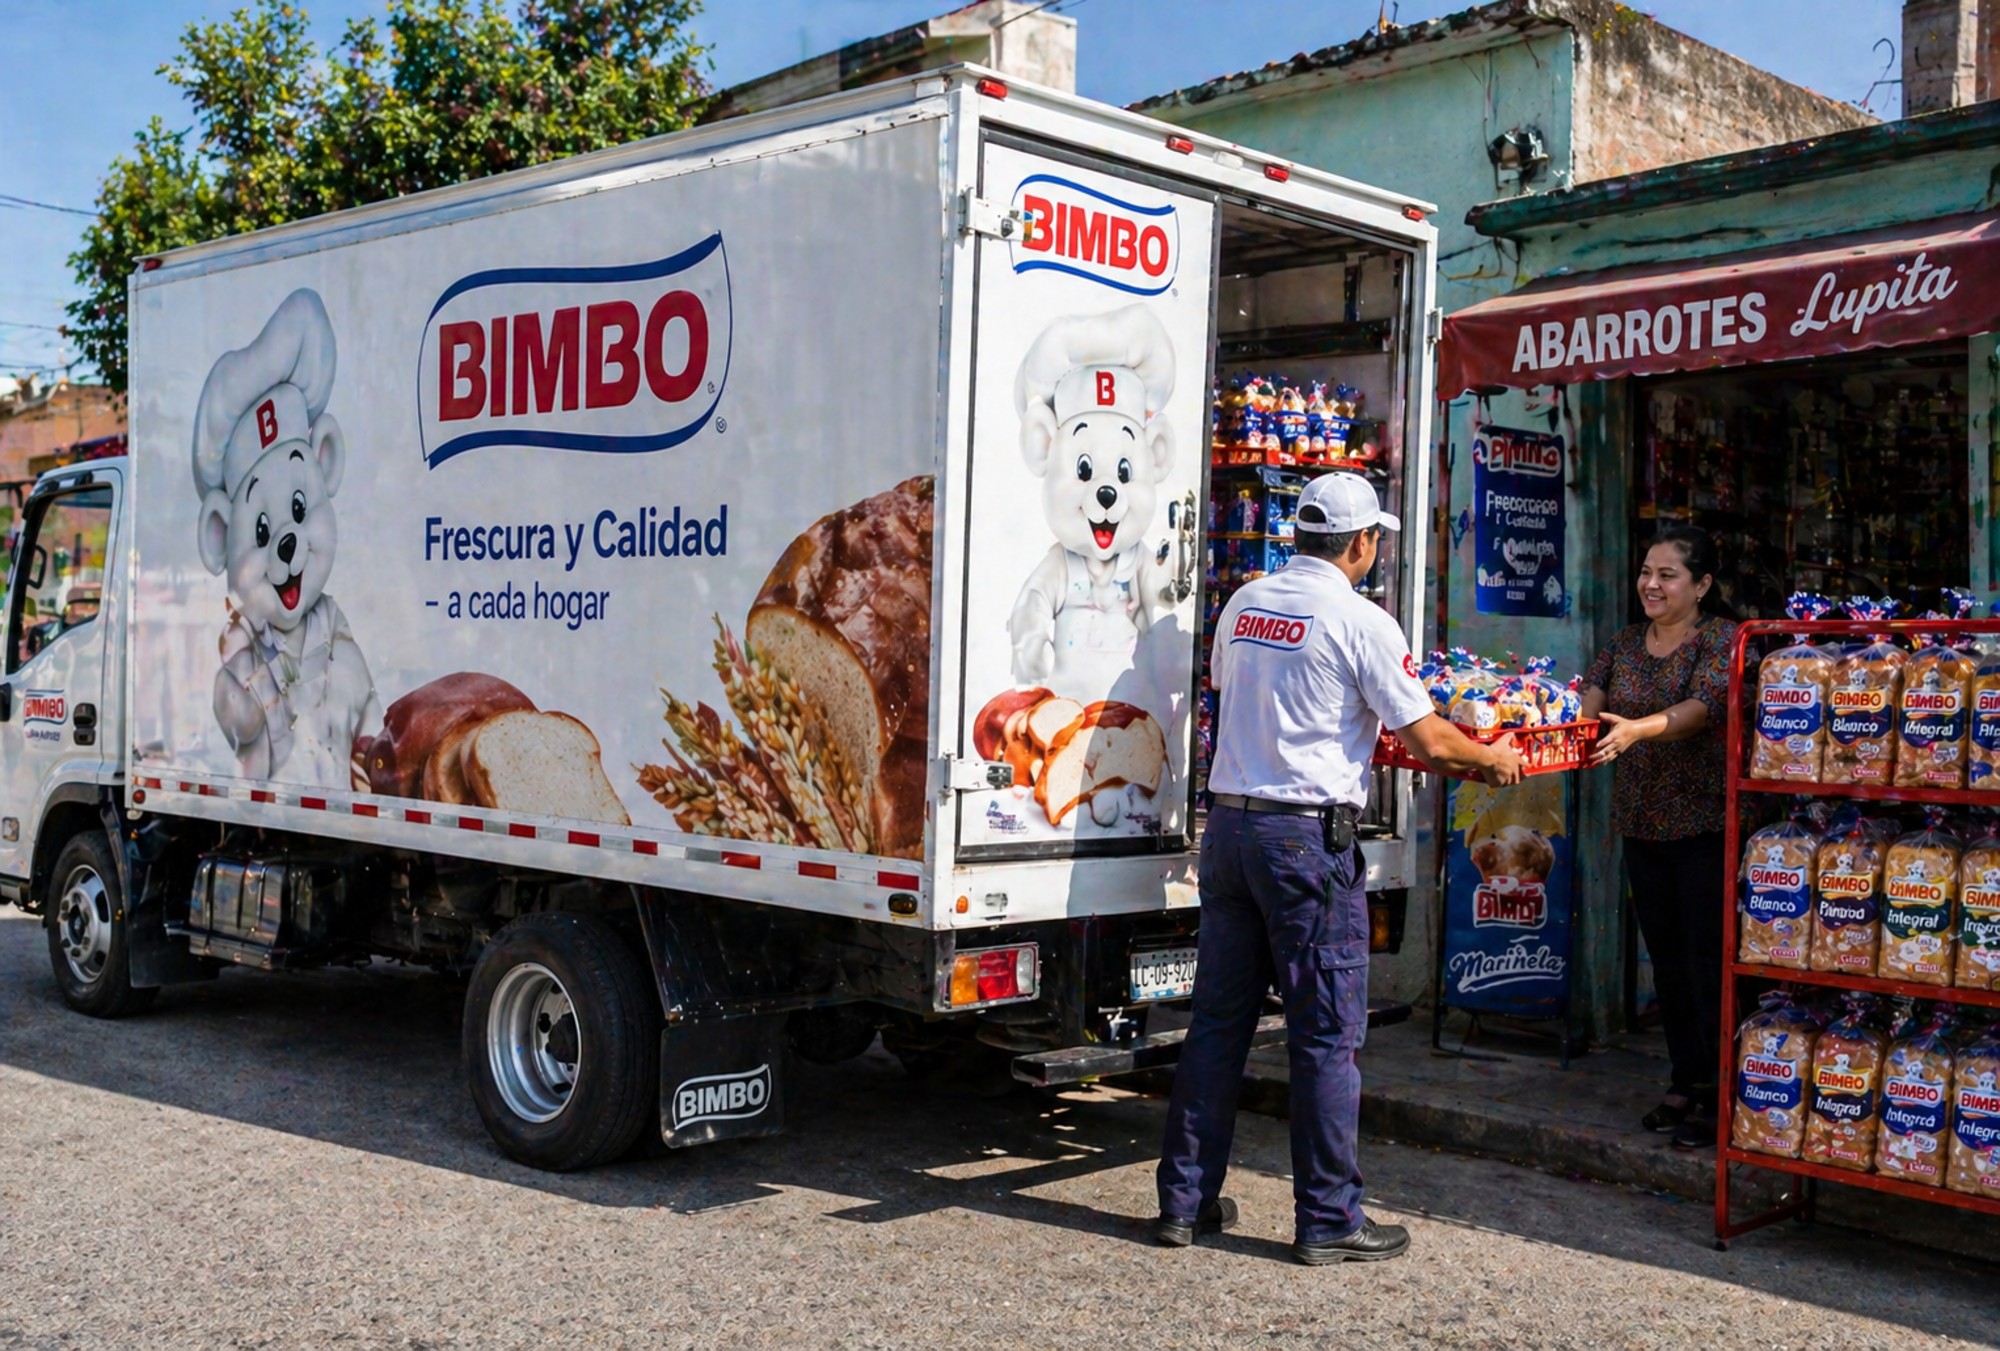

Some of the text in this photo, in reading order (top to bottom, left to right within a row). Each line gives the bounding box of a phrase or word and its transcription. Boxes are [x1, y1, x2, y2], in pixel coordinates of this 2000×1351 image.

[1022, 194, 1169, 277] BIMBO
[1512, 252, 1958, 373] ABARROTES Lupita
[439, 290, 708, 421] BIMBO
[1096, 371, 1115, 406] B
[256, 399, 278, 450] B
[425, 504, 728, 572] Frescura y Calidad
[447, 591, 461, 619] a
[469, 581, 526, 620] cada
[533, 581, 610, 631] hogar
[1234, 614, 1305, 644] BIMBO
[680, 1078, 765, 1118] BIMBO
[1888, 1082, 1938, 1101] BIMBO
